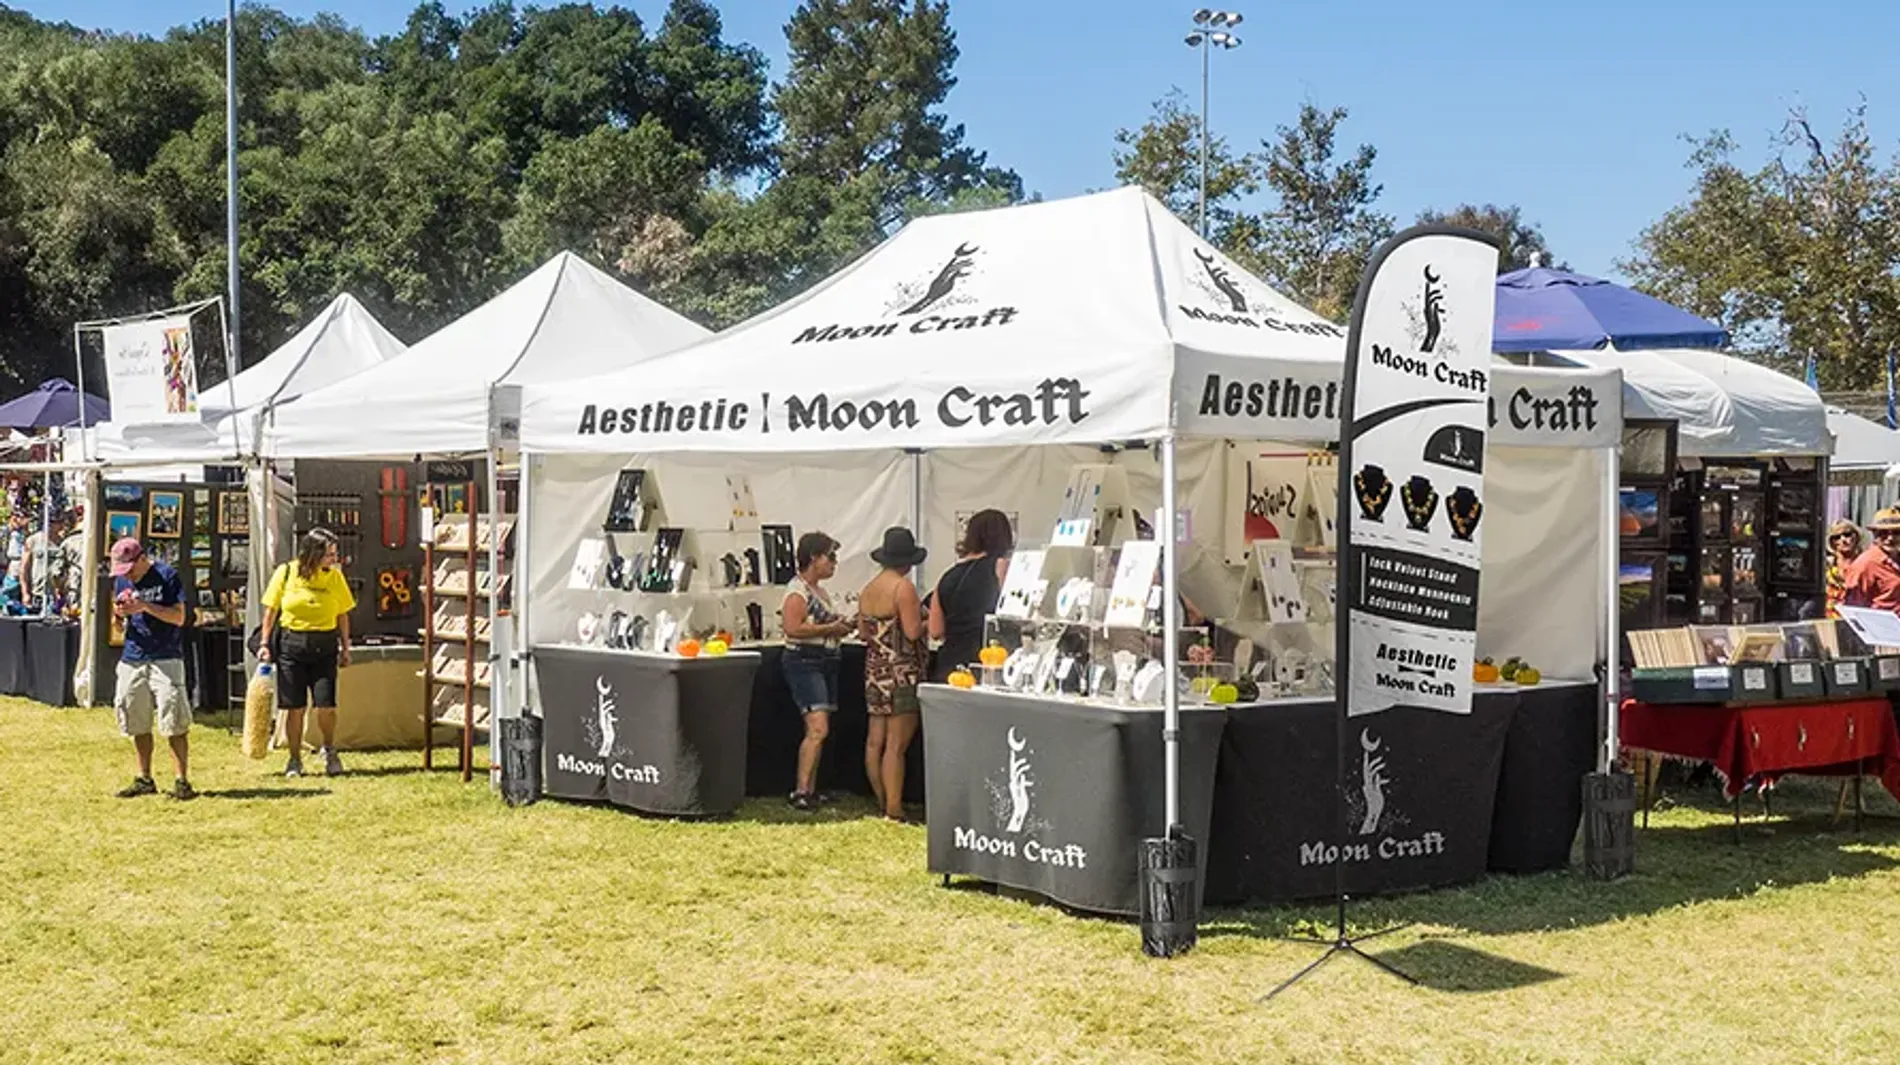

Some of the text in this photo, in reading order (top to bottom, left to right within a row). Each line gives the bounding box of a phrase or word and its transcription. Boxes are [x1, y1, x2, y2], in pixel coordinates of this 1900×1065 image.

[792, 306, 1019, 345] Moon Craft
[1178, 305, 1345, 339] Moon Craft
[1371, 343, 1488, 393] Moon Craft
[578, 377, 1091, 435] Aesthetic Moon Craft
[1199, 374, 1342, 419] Aesthet
[1509, 386, 1599, 431] Craft
[1376, 643, 1457, 671] Aesthetic
[1376, 673, 1456, 698] Moon Craft
[557, 753, 660, 785] Moon Craft
[954, 826, 1087, 869] Moon Craft
[1300, 831, 1446, 866] Moon Craft
